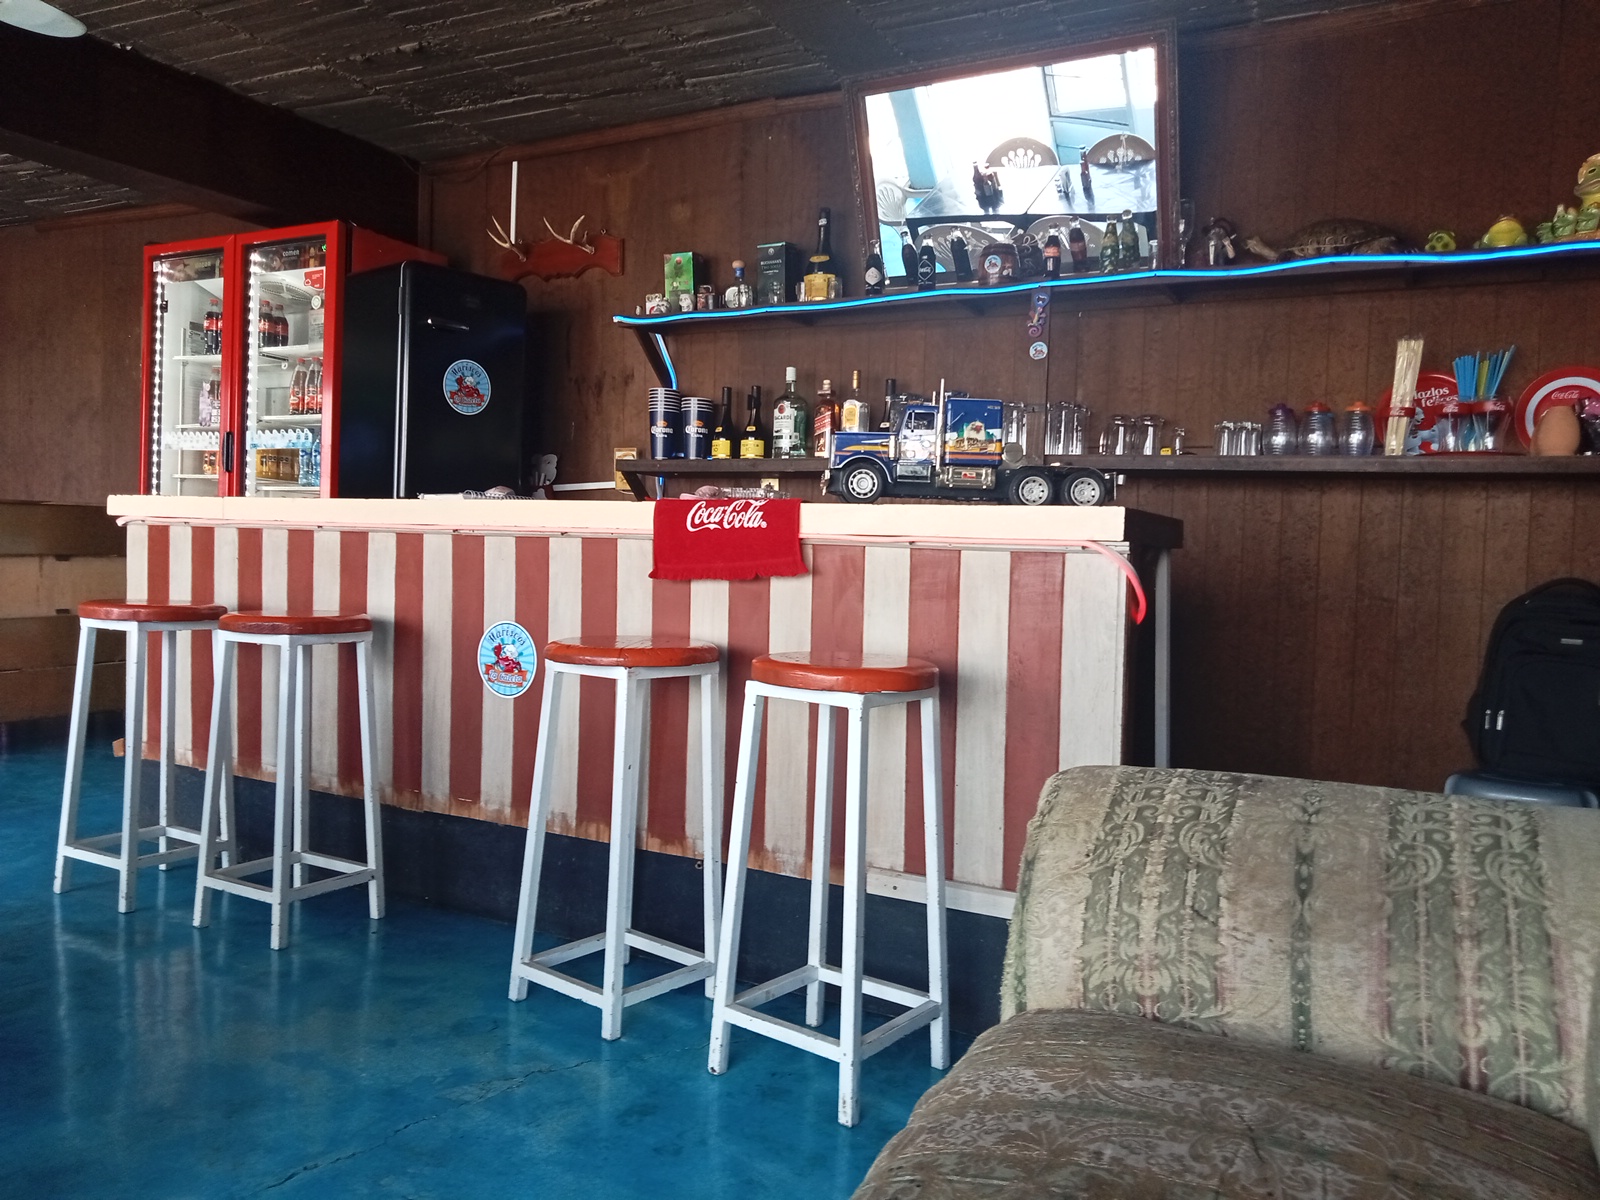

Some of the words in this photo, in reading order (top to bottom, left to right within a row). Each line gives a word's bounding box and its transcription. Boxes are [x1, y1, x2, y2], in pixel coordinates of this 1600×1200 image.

[451, 363, 482, 378] Mariscos
[651, 425, 673, 434] Corona
[685, 425, 708, 434] Corona
[686, 499, 769, 532] Coca-Cola
[488, 626, 526, 646] Mariscos
